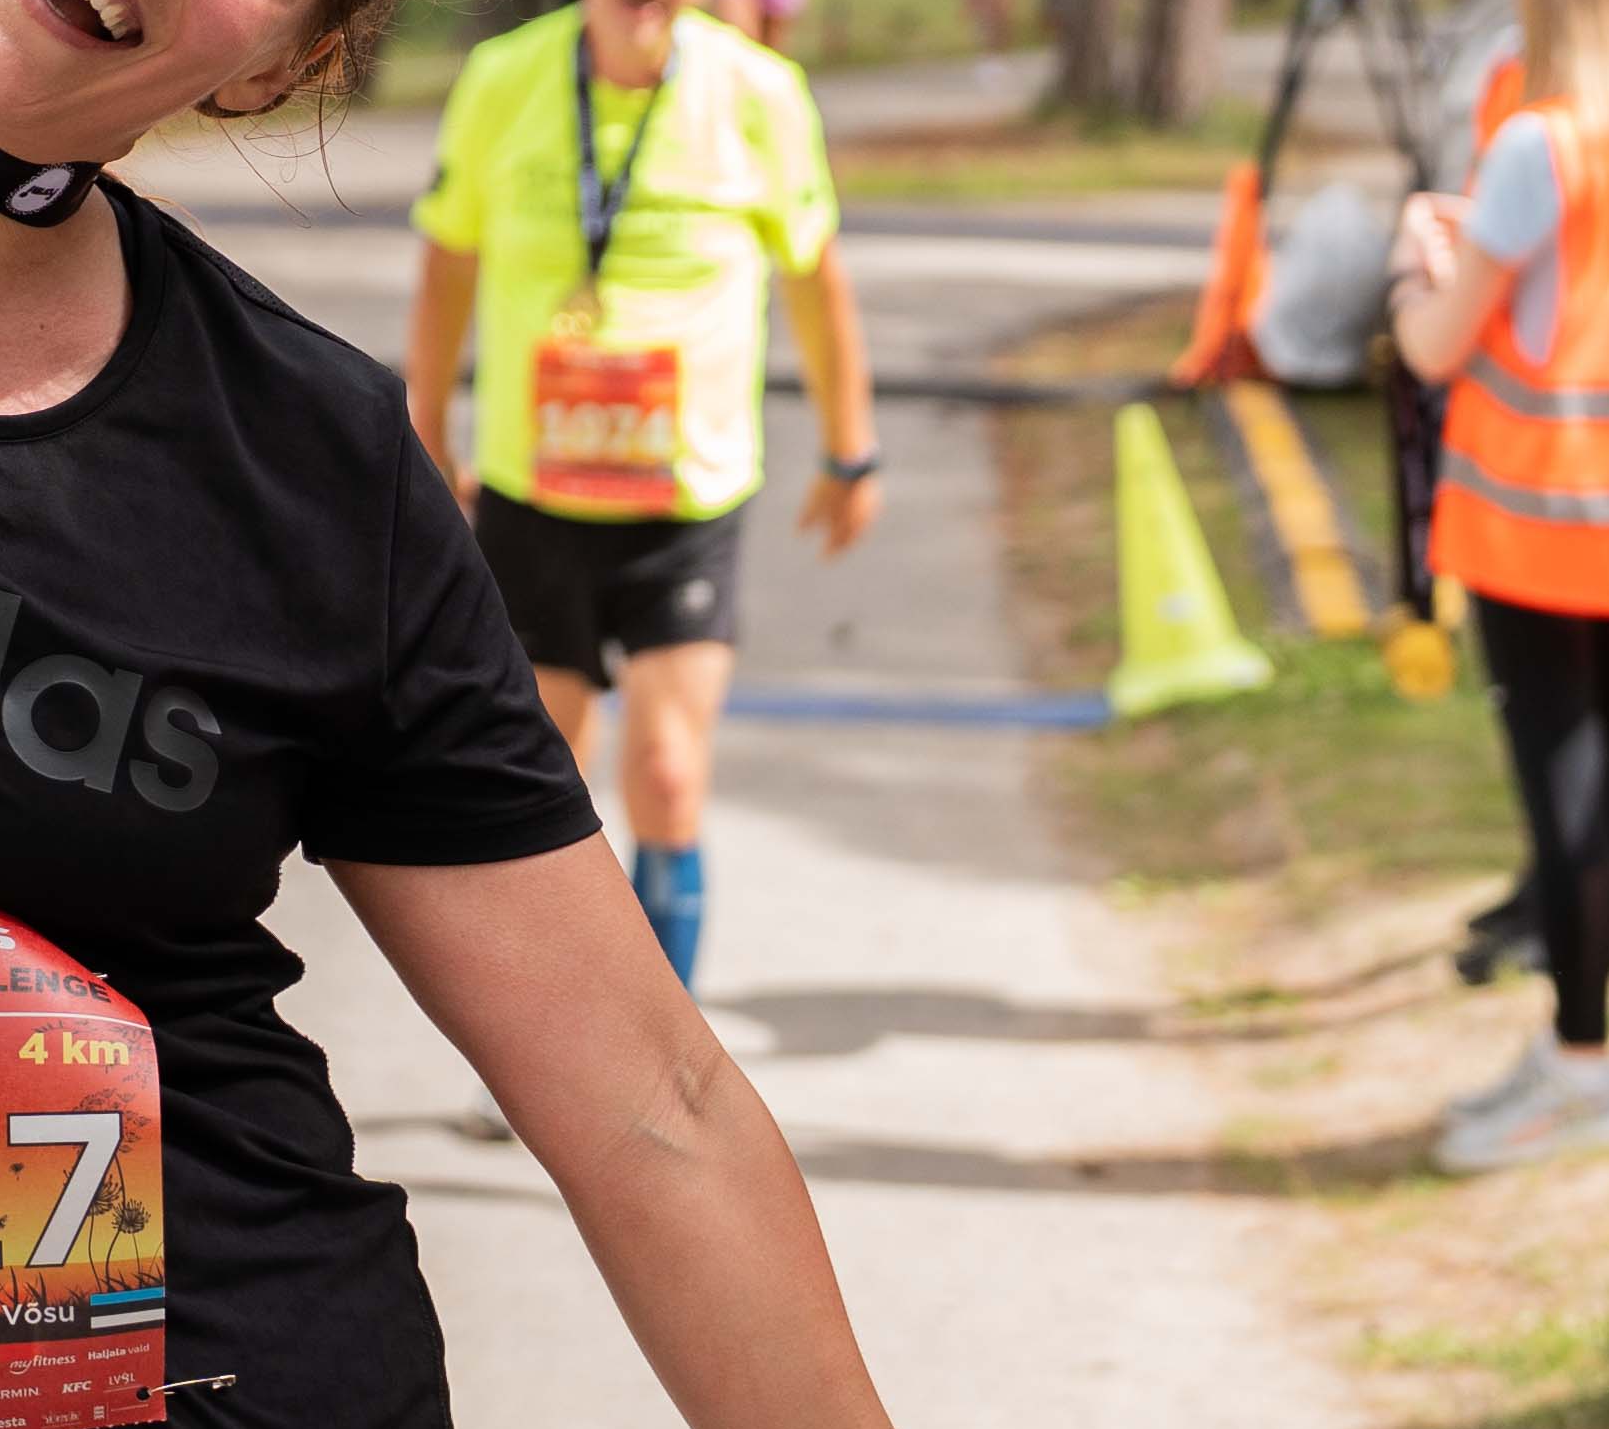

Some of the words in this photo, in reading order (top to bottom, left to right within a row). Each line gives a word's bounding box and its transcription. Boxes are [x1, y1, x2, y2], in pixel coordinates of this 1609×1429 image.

[18, 1031, 49, 1065] 4
[62, 1032, 130, 1066] km
[2, 1302, 76, 1326] Võsu
[87, 1347, 126, 1361] Haljala
[127, 1343, 151, 1355] vald
[9, 1354, 77, 1375] myfitness
[61, 1380, 92, 1394] KFC
